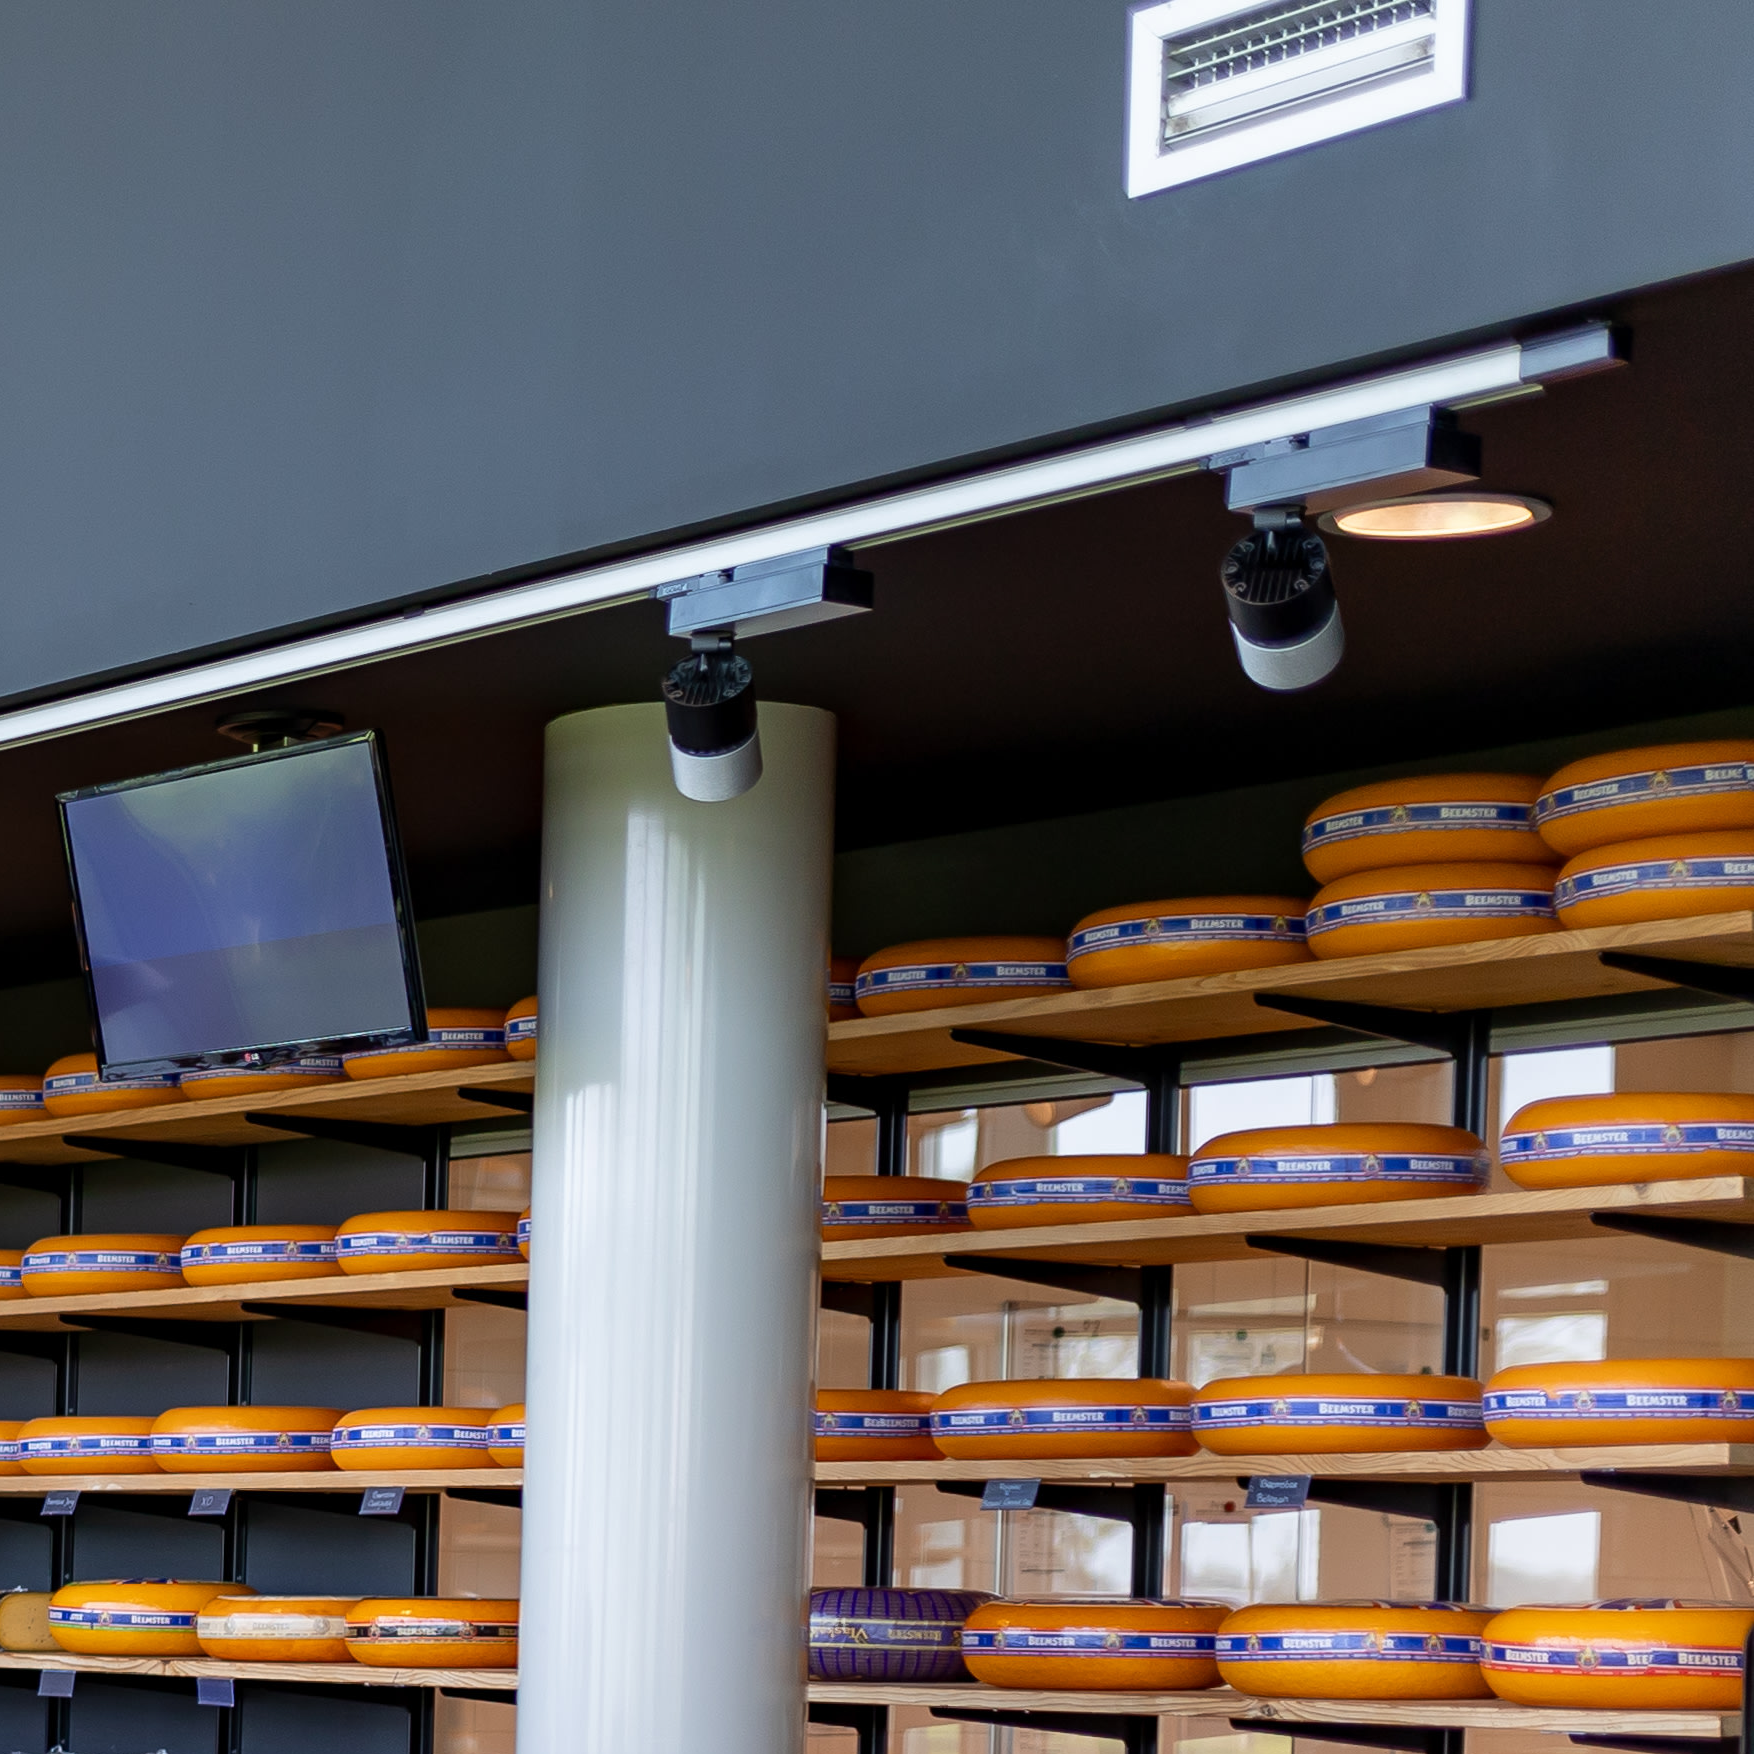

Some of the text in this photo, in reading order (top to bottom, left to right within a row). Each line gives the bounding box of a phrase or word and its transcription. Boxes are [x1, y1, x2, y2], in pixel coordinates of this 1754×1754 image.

[1440, 806, 1497, 818] BEEMSTER
[1464, 894, 1521, 906] BEEMSTER
[1190, 918, 1244, 929] BEEMSTER
[997, 966, 1046, 976] BEEMSTER
[441, 1030, 484, 1041] BEEMSTER
[1573, 1132, 1628, 1144] BEEMSTER
[1277, 1160, 1331, 1171] BEEMSTER
[1410, 1159, 1454, 1171] BEEMSTER
[1036, 1182, 1084, 1192] BEEMSTER
[868, 1205, 915, 1215] BEEMSTER
[1626, 1395, 1687, 1406] BEEMSTER
[1318, 1403, 1374, 1414] BEEMSTER
[1052, 1411, 1105, 1422] BEEMSTER
[216, 1437, 255, 1446] BEEMSTER
[131, 1615, 171, 1625] BEEMSTER
[1028, 1635, 1075, 1646] BEEMSTER
[1150, 1637, 1197, 1648] BEEMSTER
[1282, 1638, 1332, 1649] BEEMSTER
[1505, 1650, 1549, 1664] BEEMSTER
[1678, 1654, 1738, 1667] BEEMSTER
